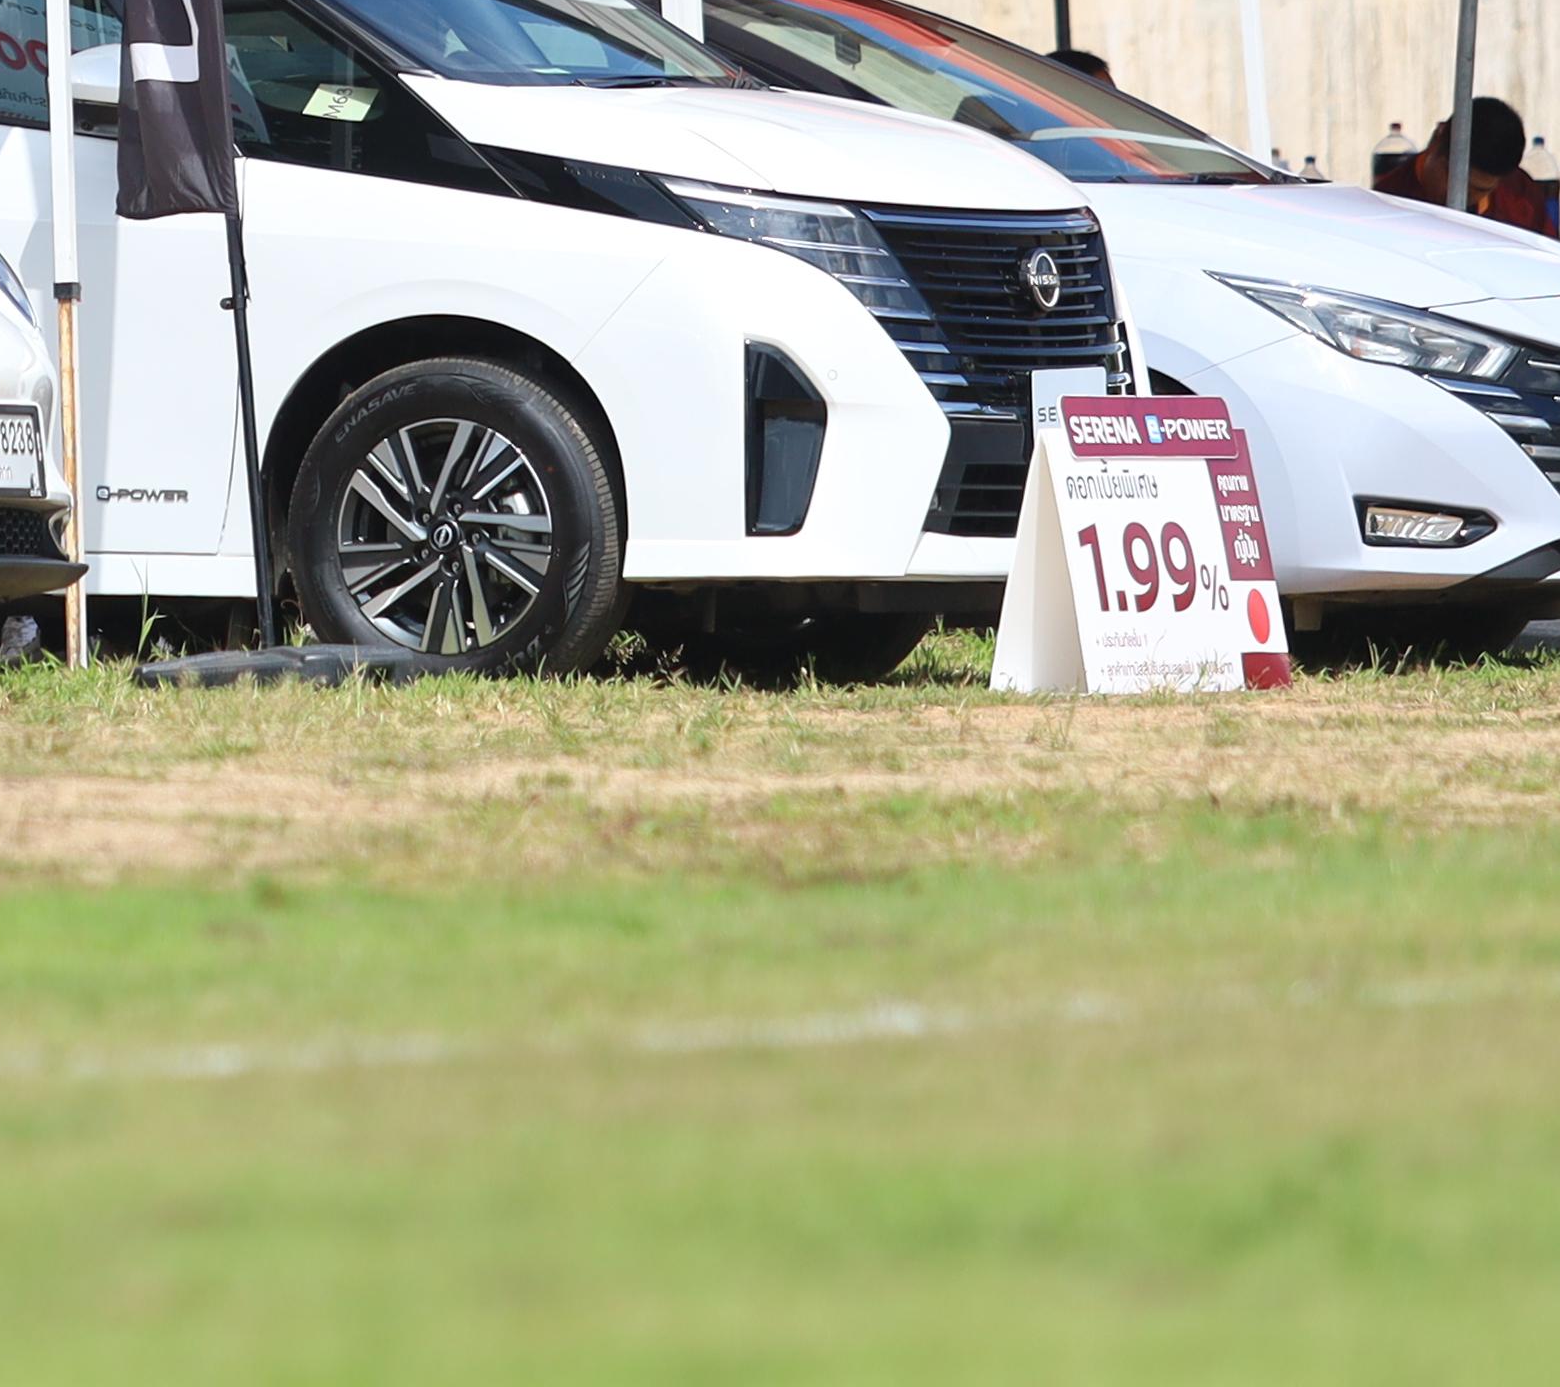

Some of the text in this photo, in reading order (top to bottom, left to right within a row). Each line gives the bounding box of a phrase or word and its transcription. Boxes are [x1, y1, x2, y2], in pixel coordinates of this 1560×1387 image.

[335, 382, 418, 444] ENASAVE
[1069, 415, 1142, 445] SERENA
[1065, 458, 1159, 500] ดอกเบี้ยพิเศษ
